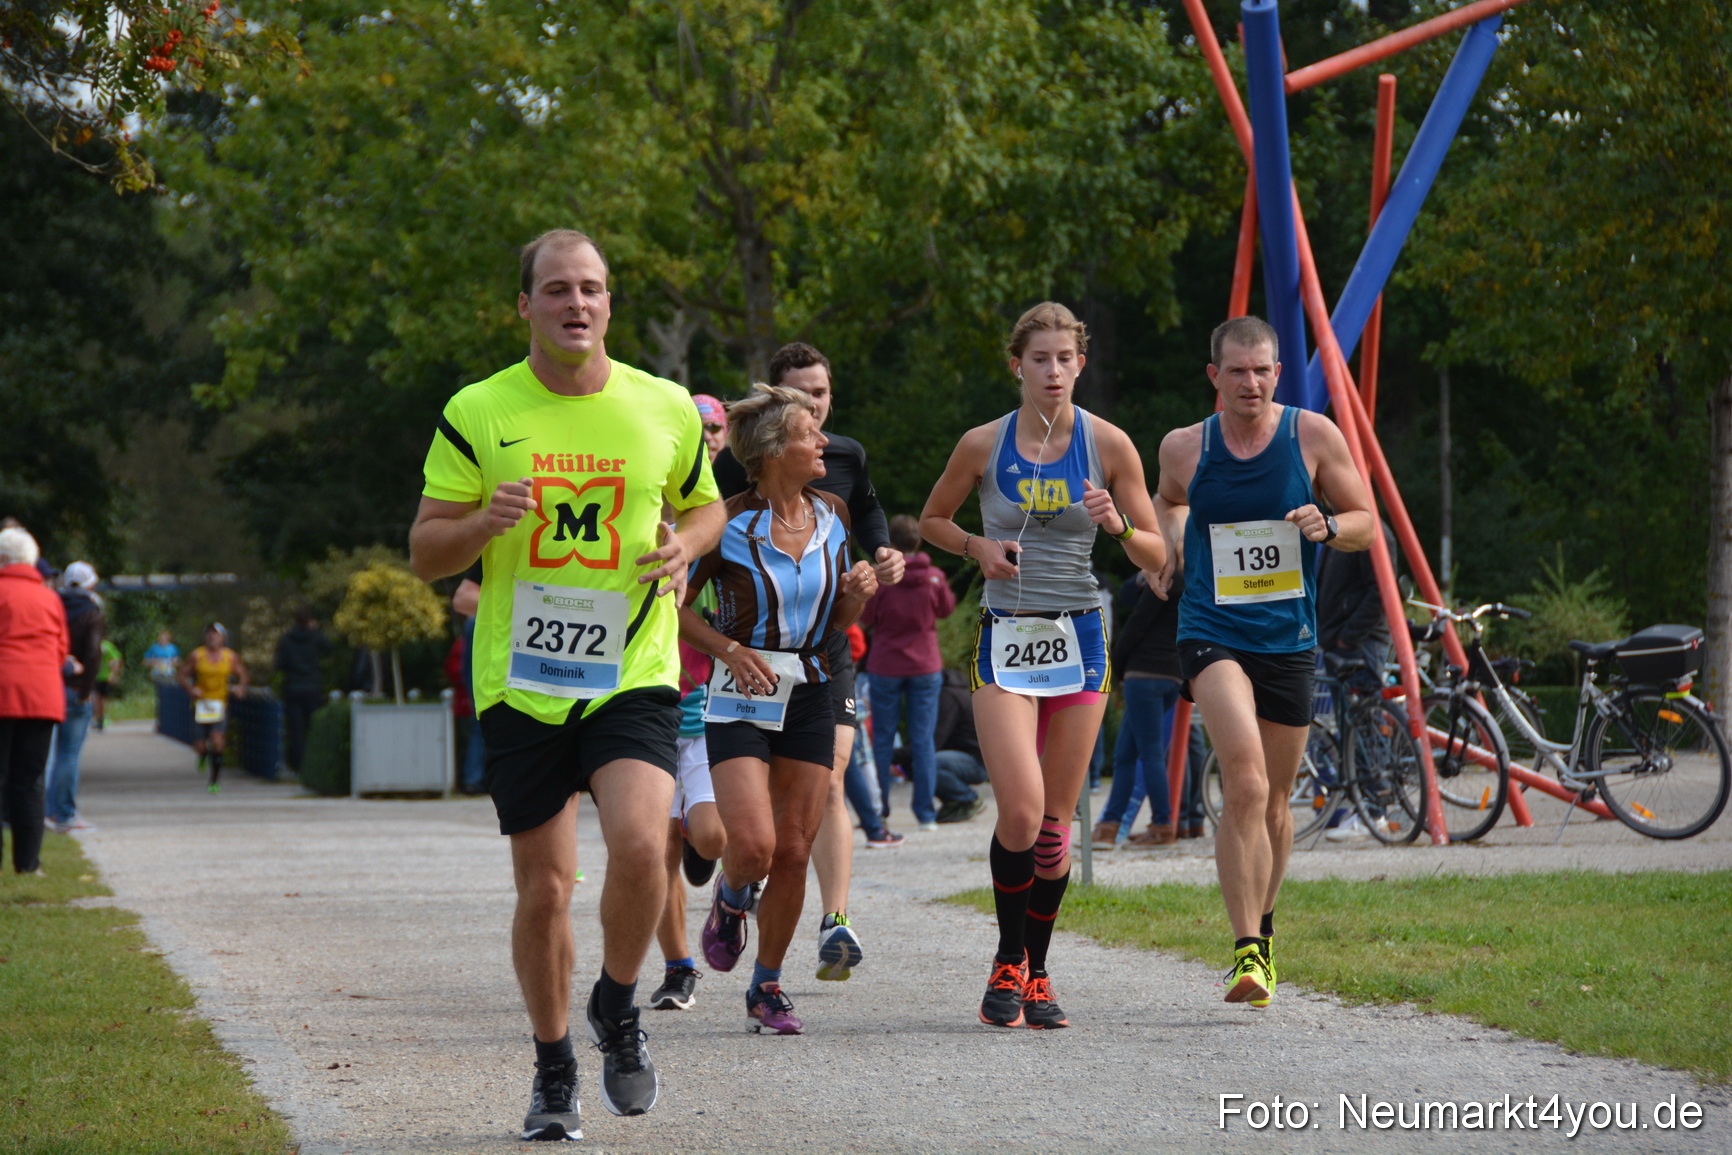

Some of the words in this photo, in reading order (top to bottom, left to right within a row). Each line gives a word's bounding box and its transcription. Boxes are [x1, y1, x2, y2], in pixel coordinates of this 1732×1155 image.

[531, 453, 626, 472] Müller
[1016, 478, 1072, 511] SVA
[552, 503, 601, 541] M
[1234, 545, 1280, 571] 139
[1243, 579, 1275, 589] Steffen
[554, 596, 595, 609] BOCK
[526, 617, 607, 656] 2372
[1005, 638, 1068, 668] 2428
[540, 662, 586, 679] Dominik
[1028, 674, 1050, 684] Julia
[736, 703, 757, 714] Petra
